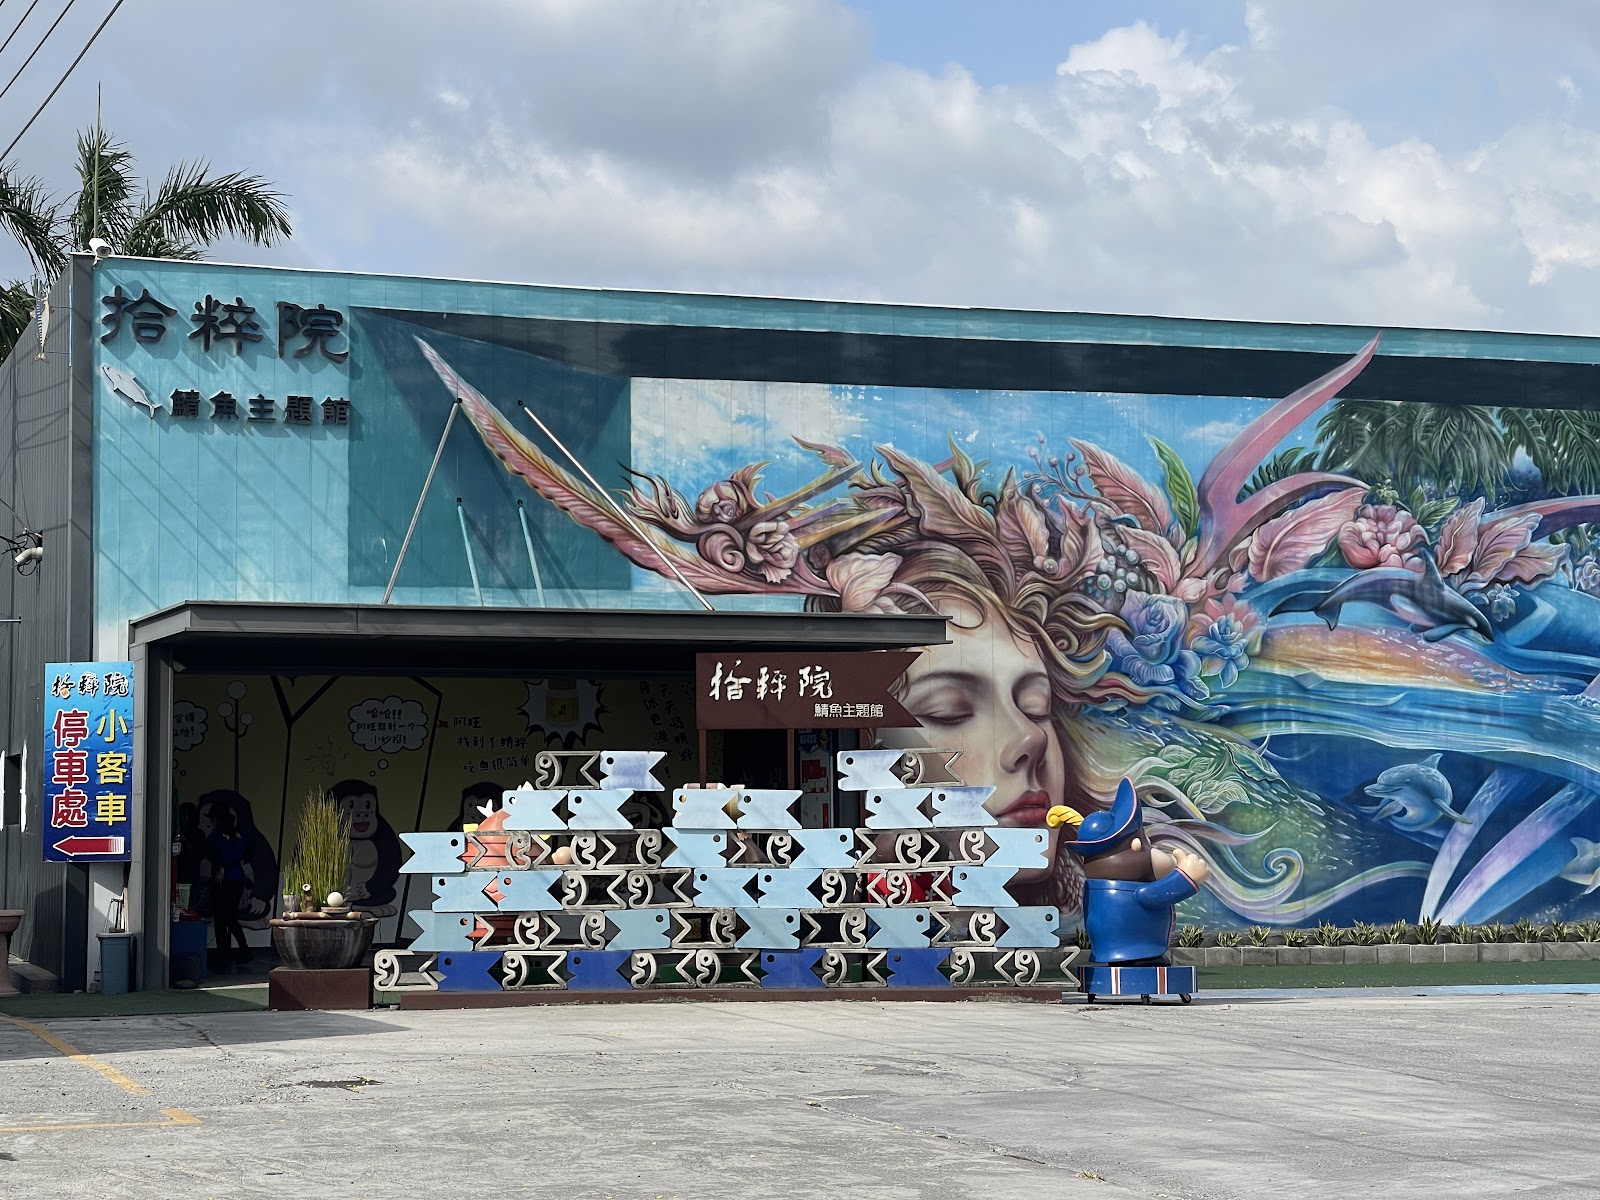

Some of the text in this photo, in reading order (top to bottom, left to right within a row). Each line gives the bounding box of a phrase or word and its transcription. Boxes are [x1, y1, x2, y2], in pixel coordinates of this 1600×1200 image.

[100, 285, 349, 363] 拾粹院
[170, 388, 351, 425] 鯖魚主題館
[814, 703, 884, 718] 鯖魚主題館
[52, 709, 89, 828] 停車處
[94, 709, 128, 826] 小客車
